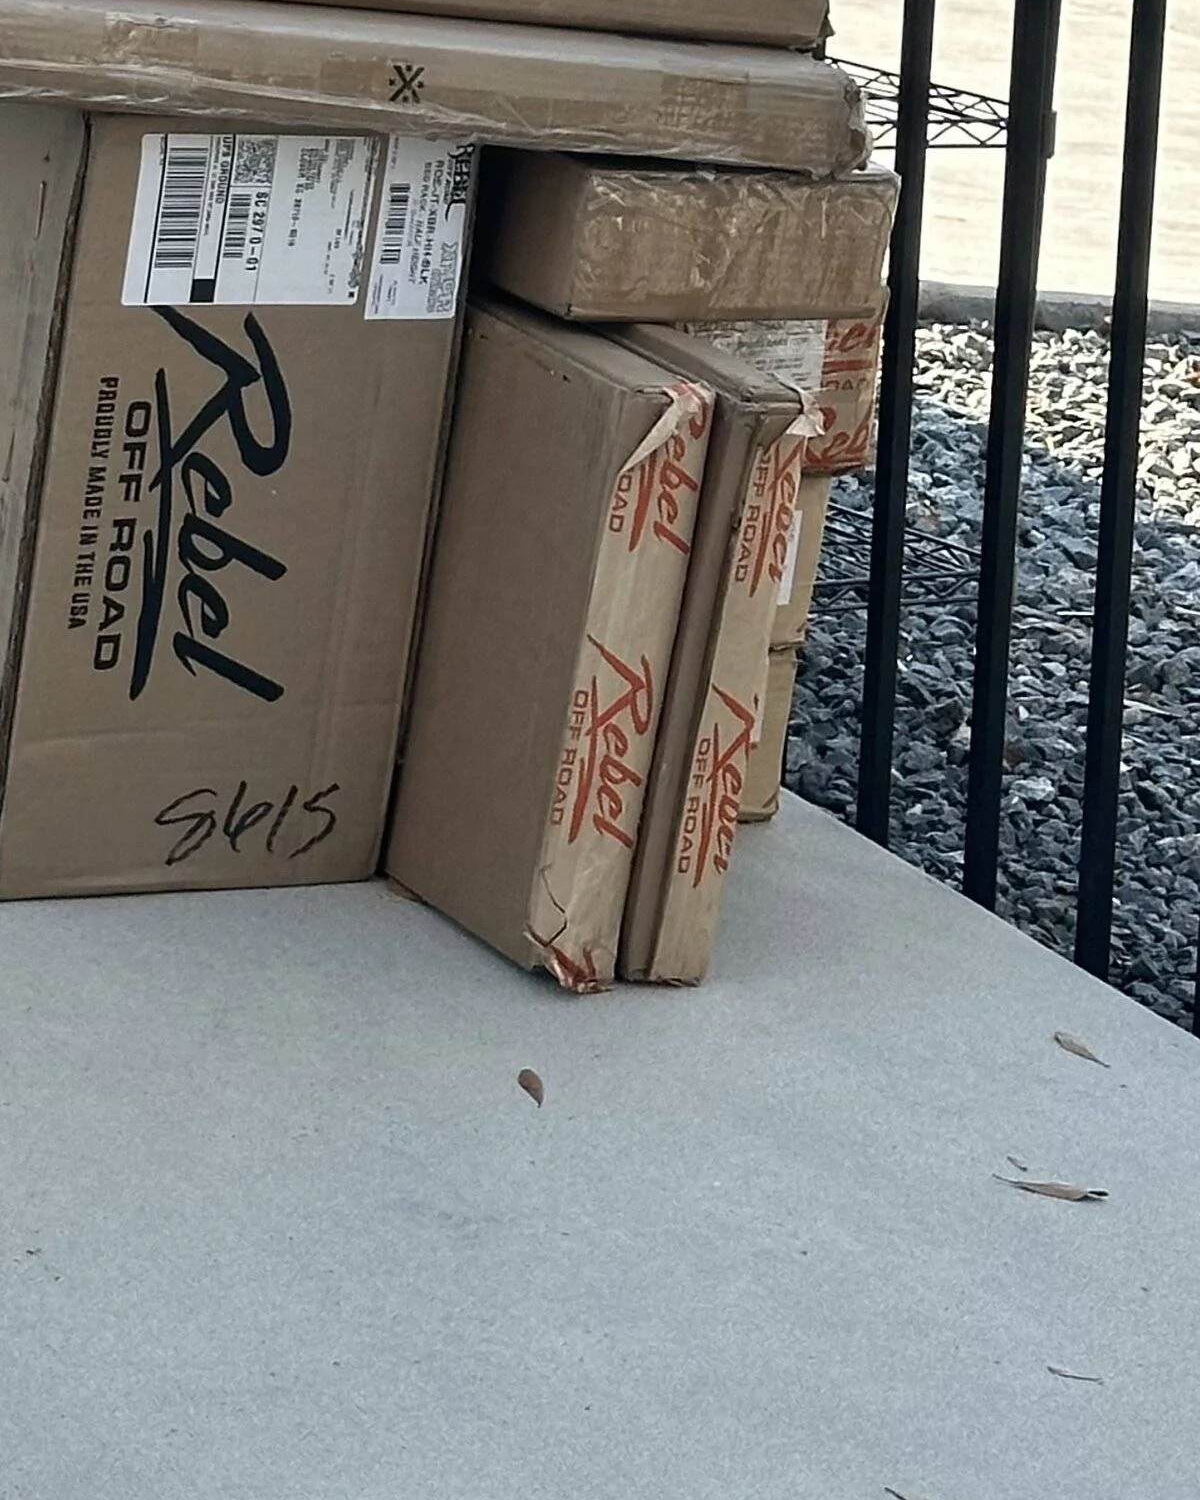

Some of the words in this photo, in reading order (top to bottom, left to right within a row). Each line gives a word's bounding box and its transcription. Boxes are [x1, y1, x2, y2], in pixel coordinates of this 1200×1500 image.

[91, 376, 120, 459] PROUDLY
[118, 400, 152, 502] OFF
[82, 466, 108, 520] MADE
[149, 304, 293, 702] Rebel
[608, 468, 634, 533] OAD
[73, 551, 96, 588] THE
[79, 525, 100, 547] IN
[735, 505, 761, 583] ROAD
[67, 592, 92, 630] USA
[93, 517, 137, 671] ROAD
[569, 690, 589, 740] OFF
[585, 634, 653, 849] Rebel
[551, 748, 577, 825] ROAD
[692, 738, 711, 791] OFF
[678, 797, 700, 873] ROAD
